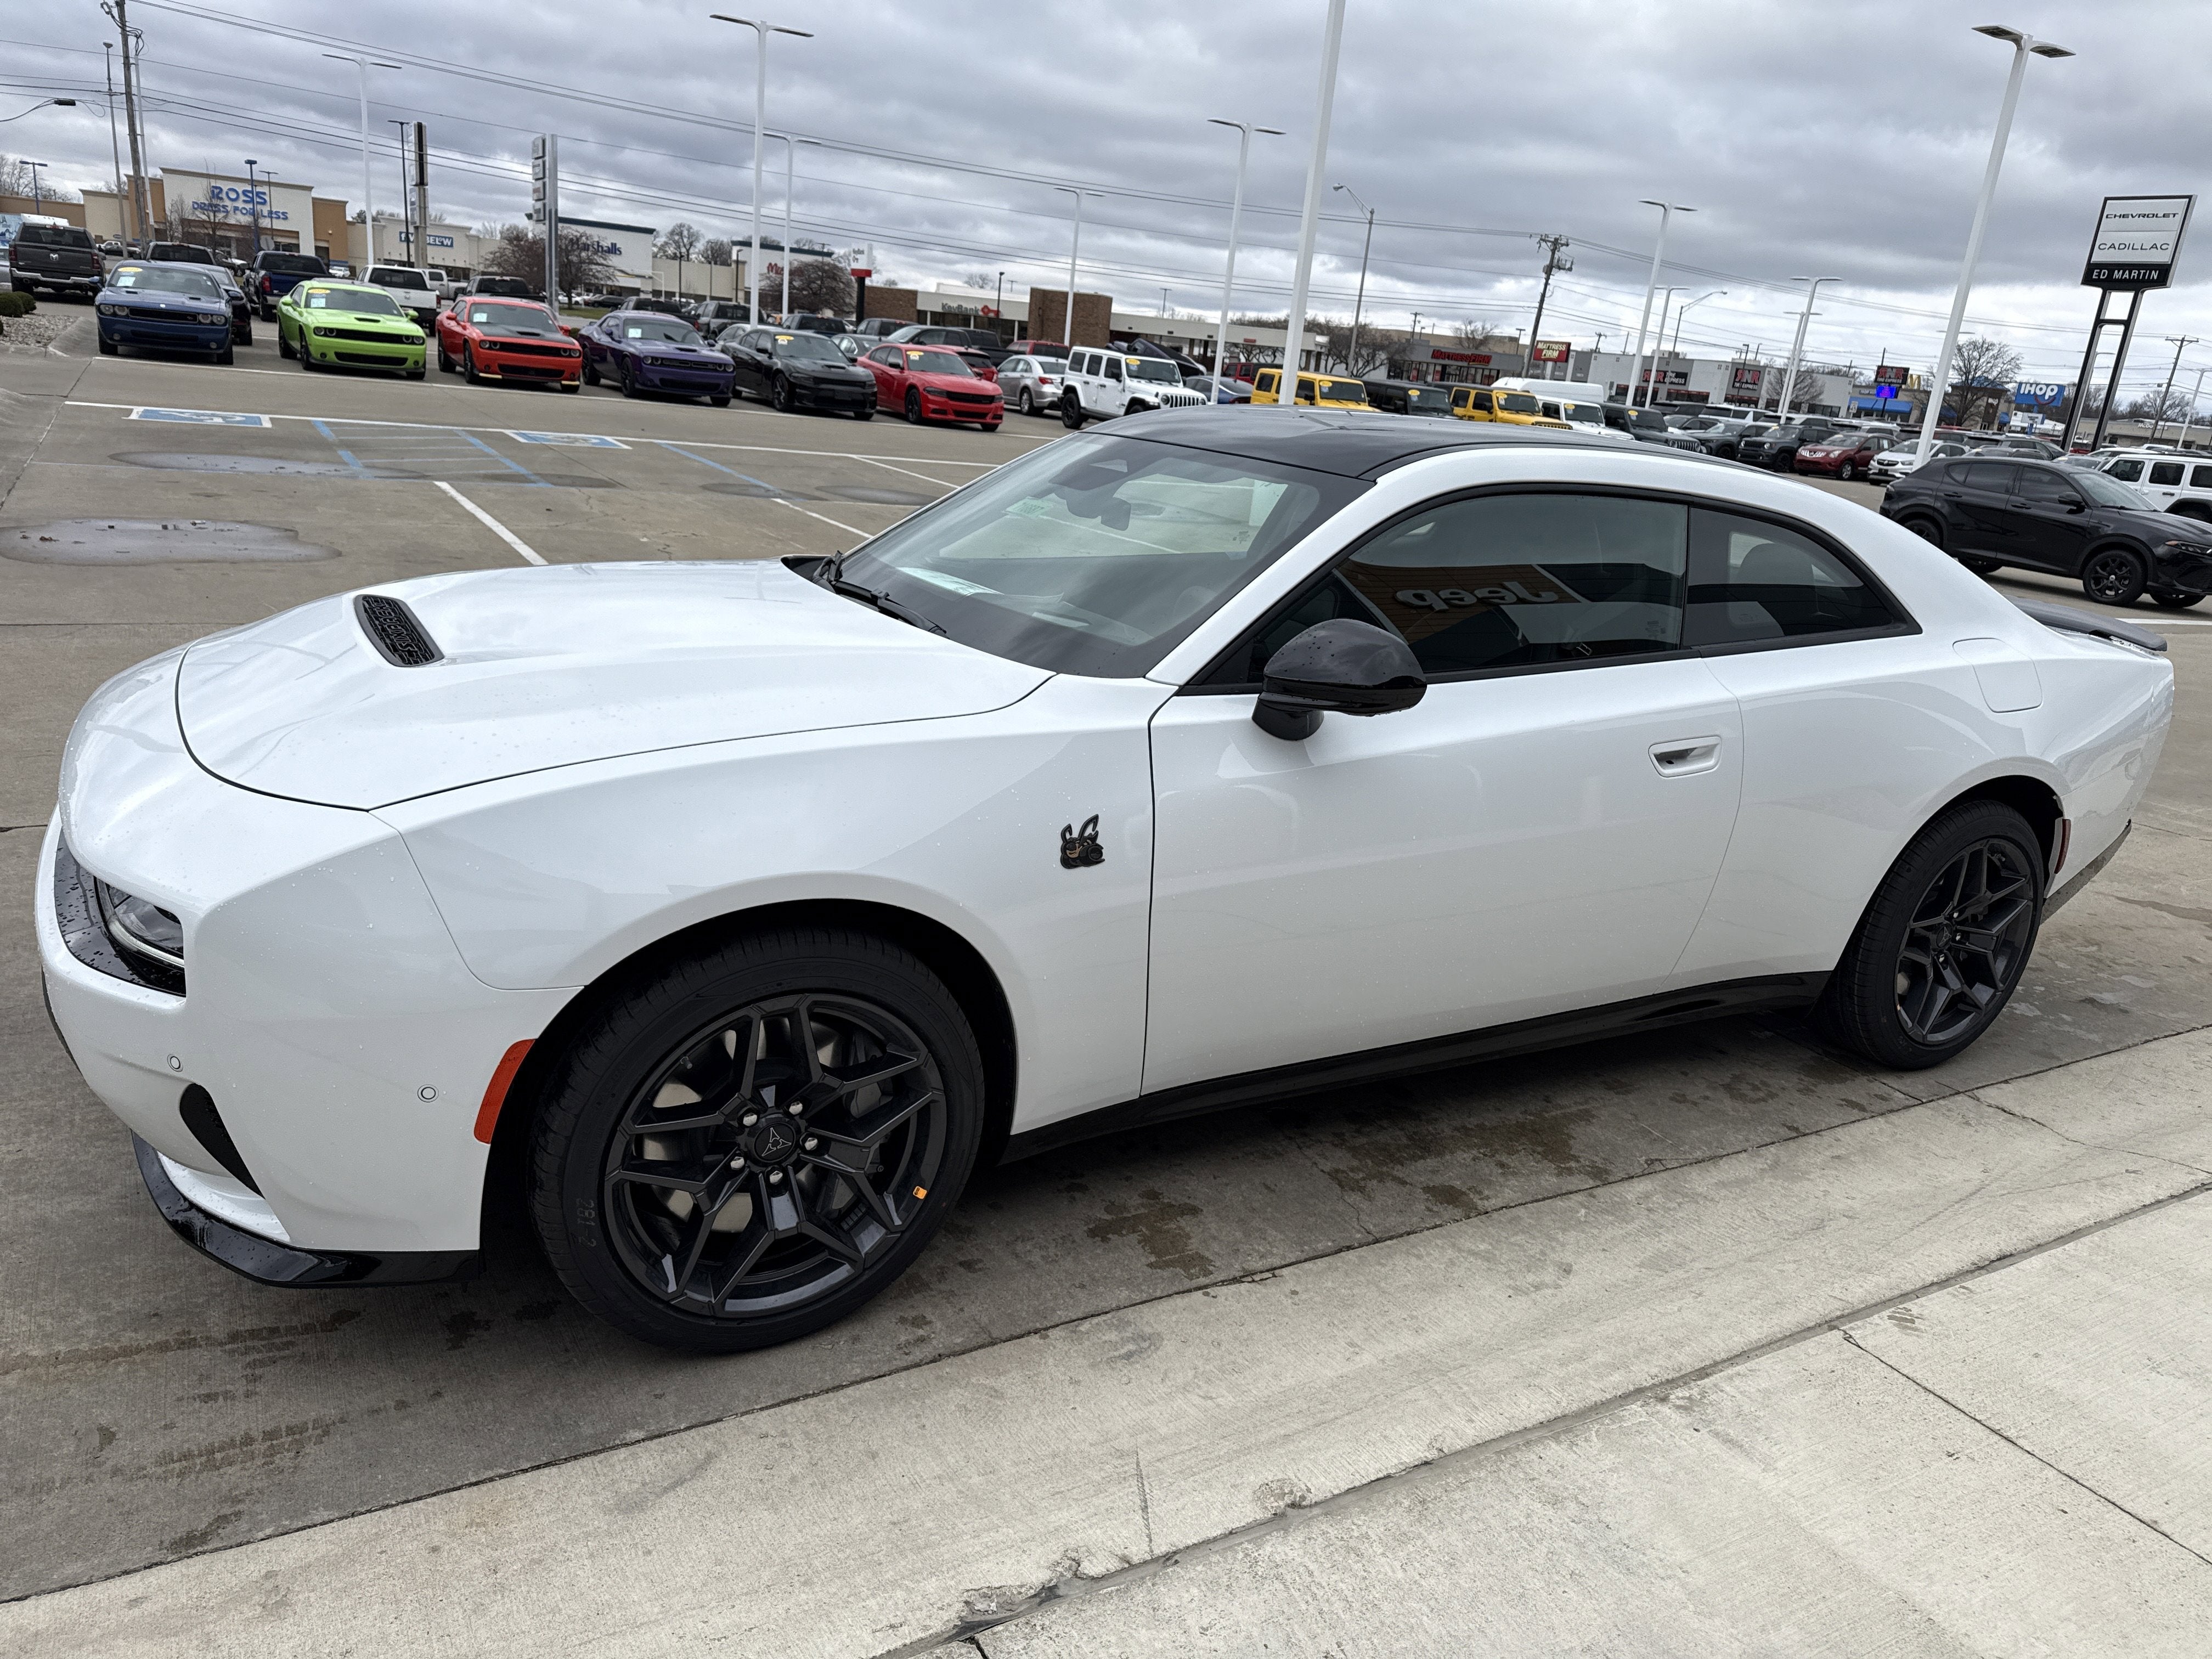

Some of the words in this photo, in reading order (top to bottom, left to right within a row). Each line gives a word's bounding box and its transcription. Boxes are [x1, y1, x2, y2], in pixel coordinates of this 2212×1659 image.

[211, 185, 267, 205] ROSS
[261, 209, 289, 220] LESS
[2092, 269, 2108, 279] ED
[2113, 269, 2159, 280] MARTIN
[941, 302, 980, 316] KeyBank
[1537, 342, 1567, 351] MATTRESS
[1542, 349, 1559, 358] FIRM
